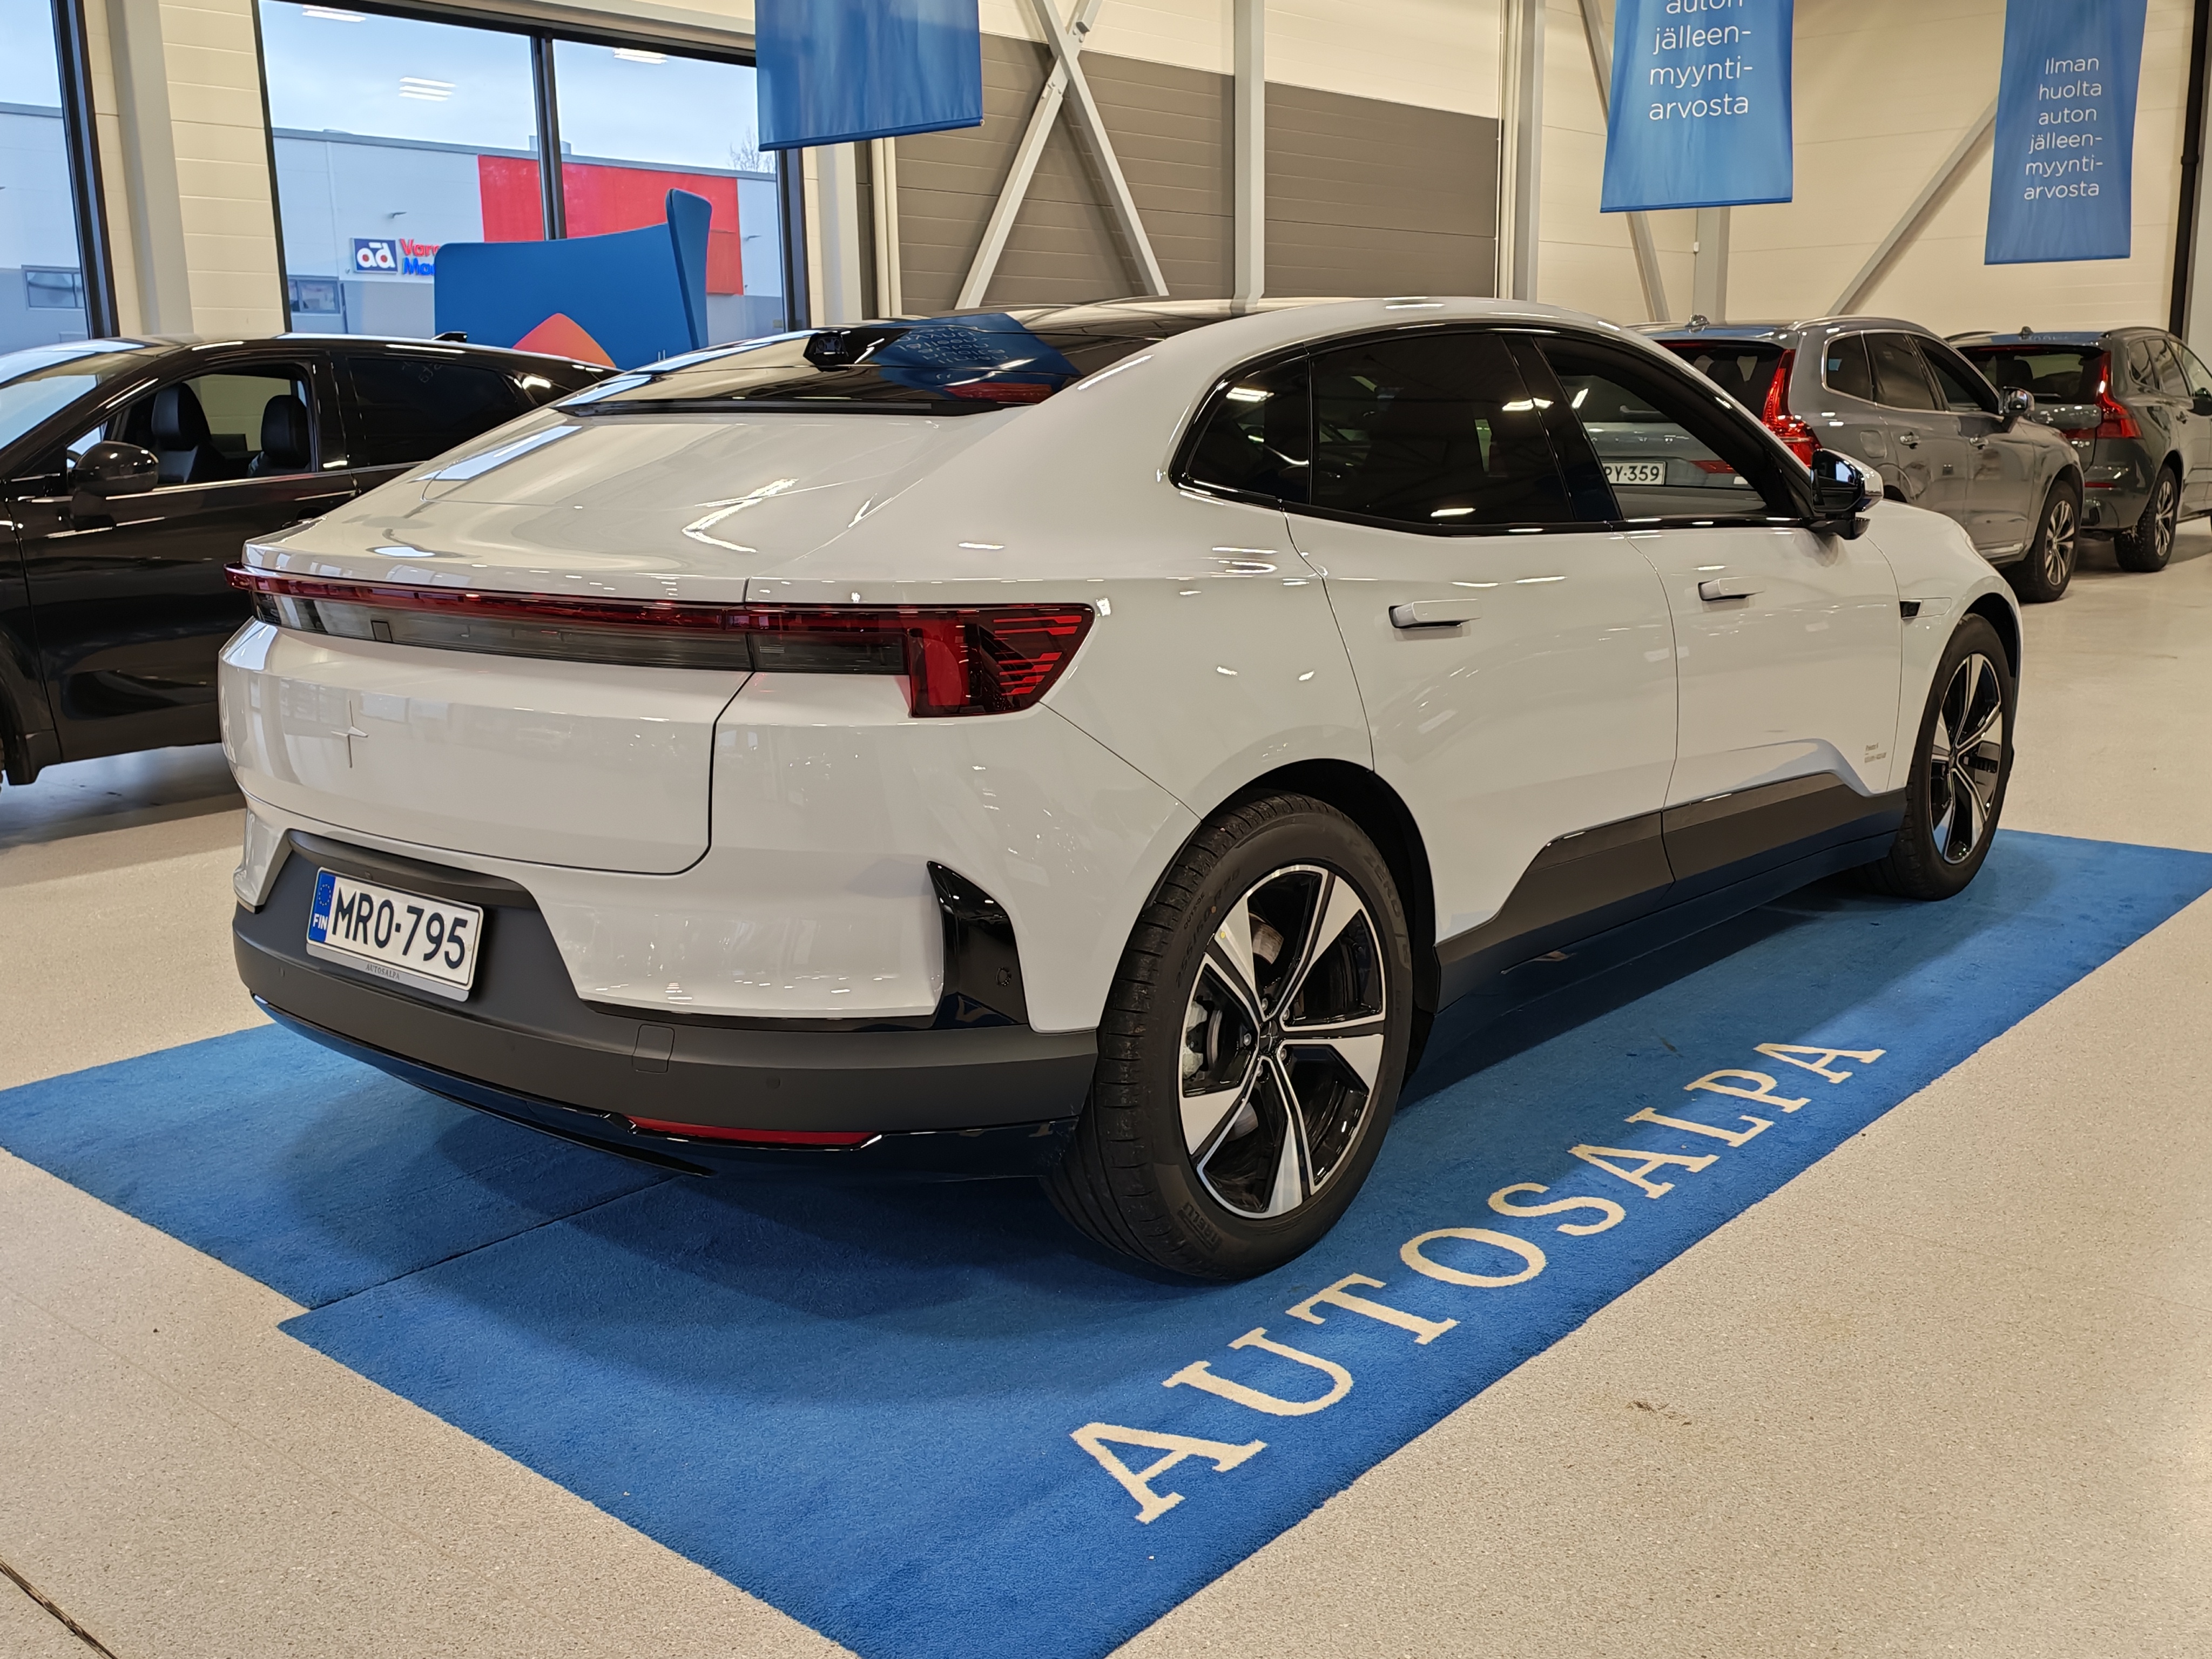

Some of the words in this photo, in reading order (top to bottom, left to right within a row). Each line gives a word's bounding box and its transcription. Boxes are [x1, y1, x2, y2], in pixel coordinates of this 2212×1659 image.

[1653, 24, 1752, 55] jälleen-
[1649, 55, 1754, 89] myynti-
[2045, 57, 2099, 75] Ilman
[2039, 80, 2102, 100] huolta
[1649, 93, 1749, 120] arvosta
[2039, 107, 2097, 125] auton
[2028, 132, 2102, 154] jälleen-
[2026, 154, 2103, 177] myynti-
[2024, 180, 2099, 200] arvosta
[313, 913, 328, 930] FIN
[332, 886, 468, 969] MRO-795
[366, 963, 400, 980] AUTOSALPA
[1069, 1041, 1887, 1524] AUTOSALPA
